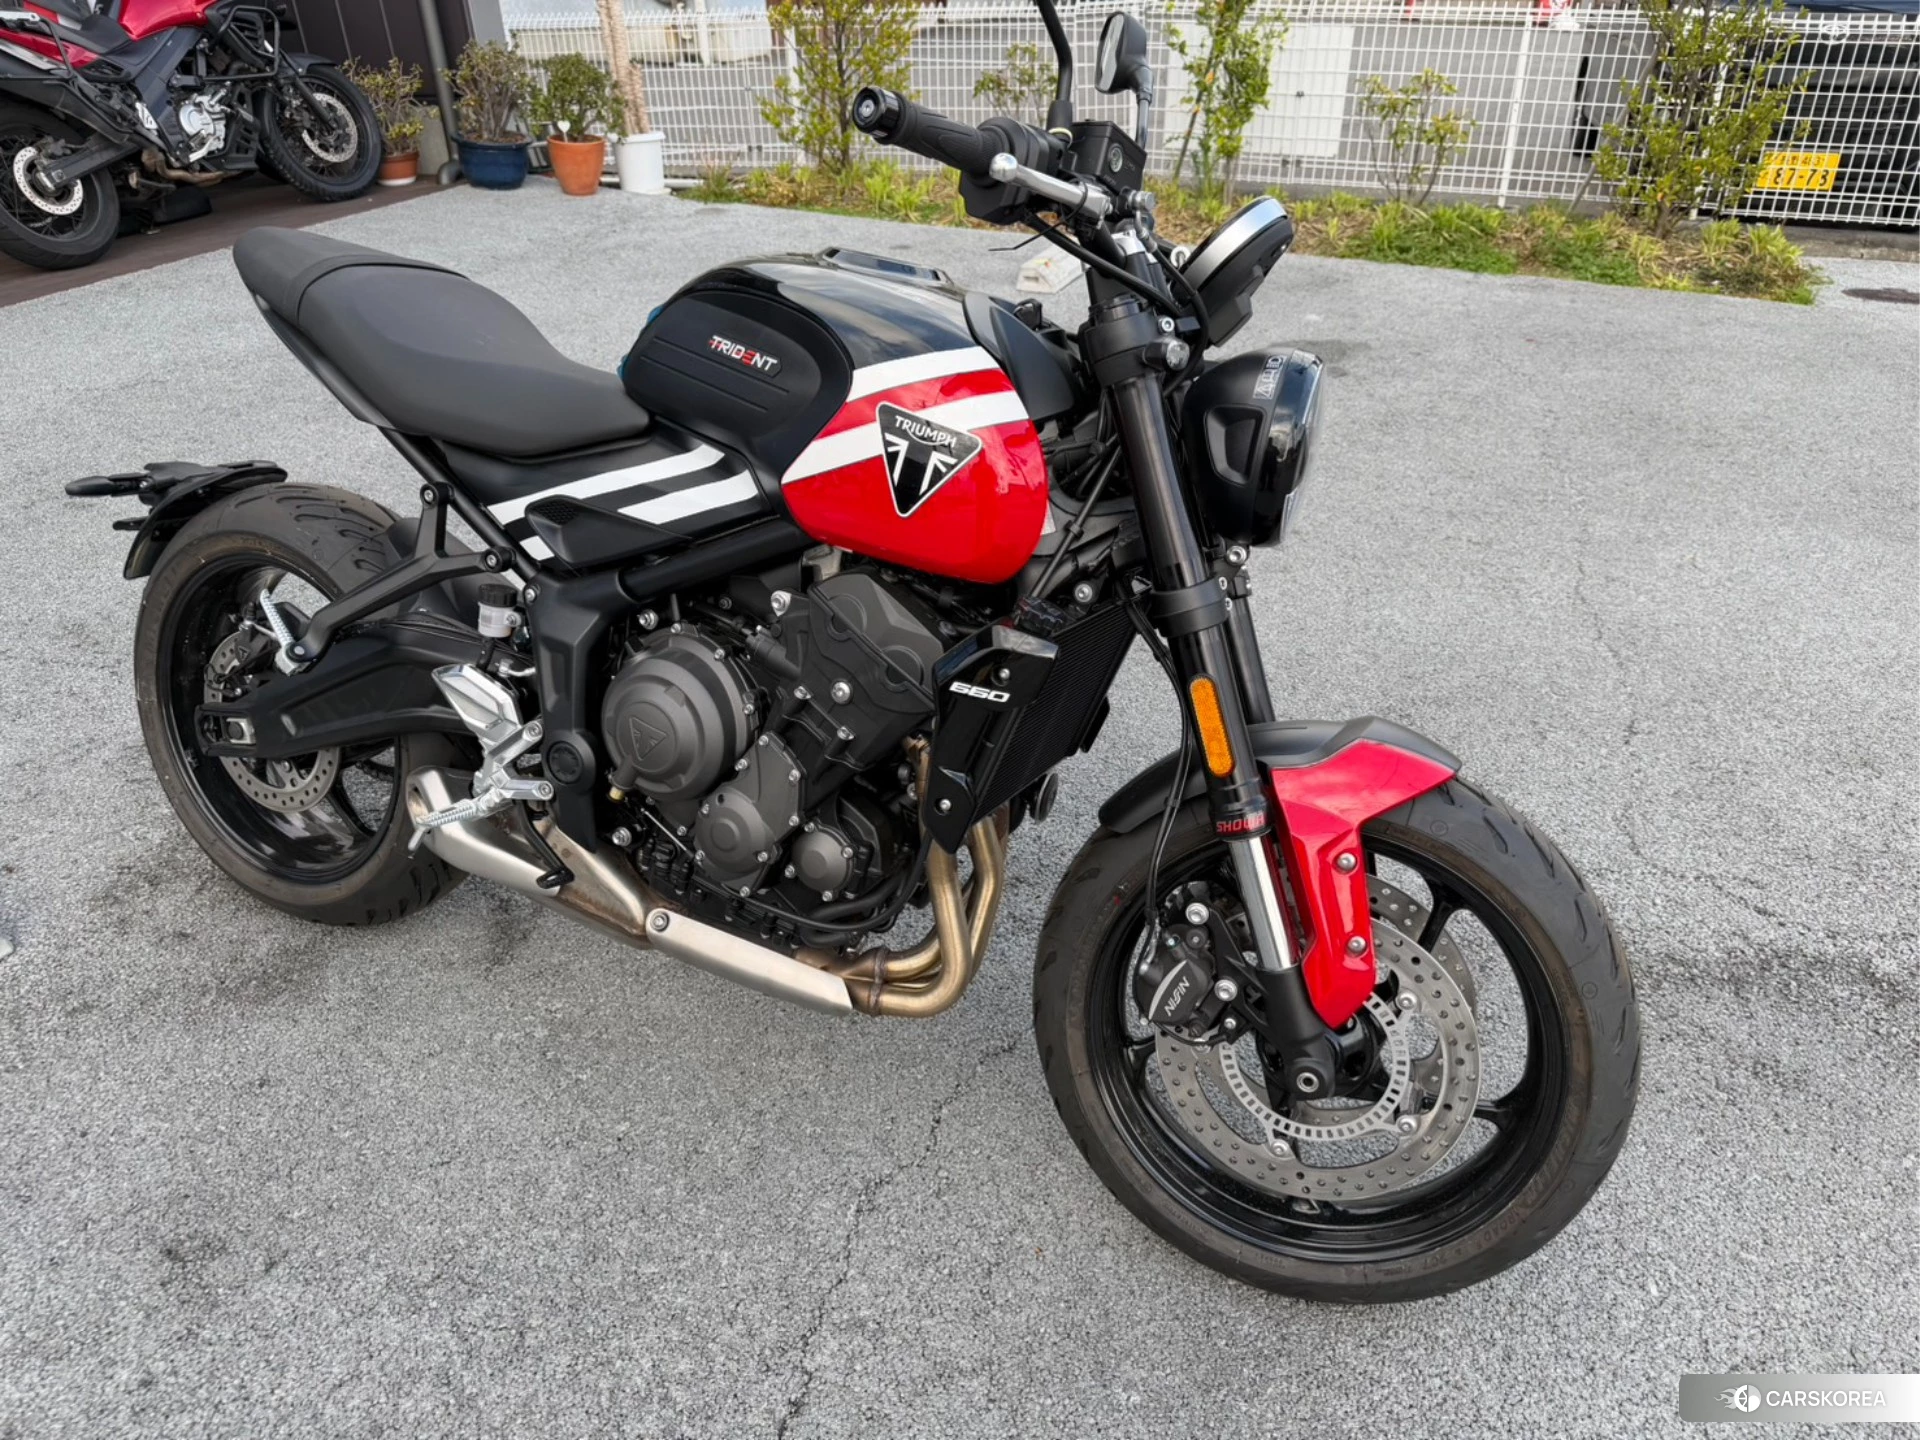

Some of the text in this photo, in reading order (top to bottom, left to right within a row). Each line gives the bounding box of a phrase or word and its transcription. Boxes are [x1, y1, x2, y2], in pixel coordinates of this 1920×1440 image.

[708, 334, 778, 371] TRIDENT
[895, 415, 957, 448] TRIUMPH
[949, 681, 1010, 703] 660
[1164, 976, 1190, 1017] NISSIN
